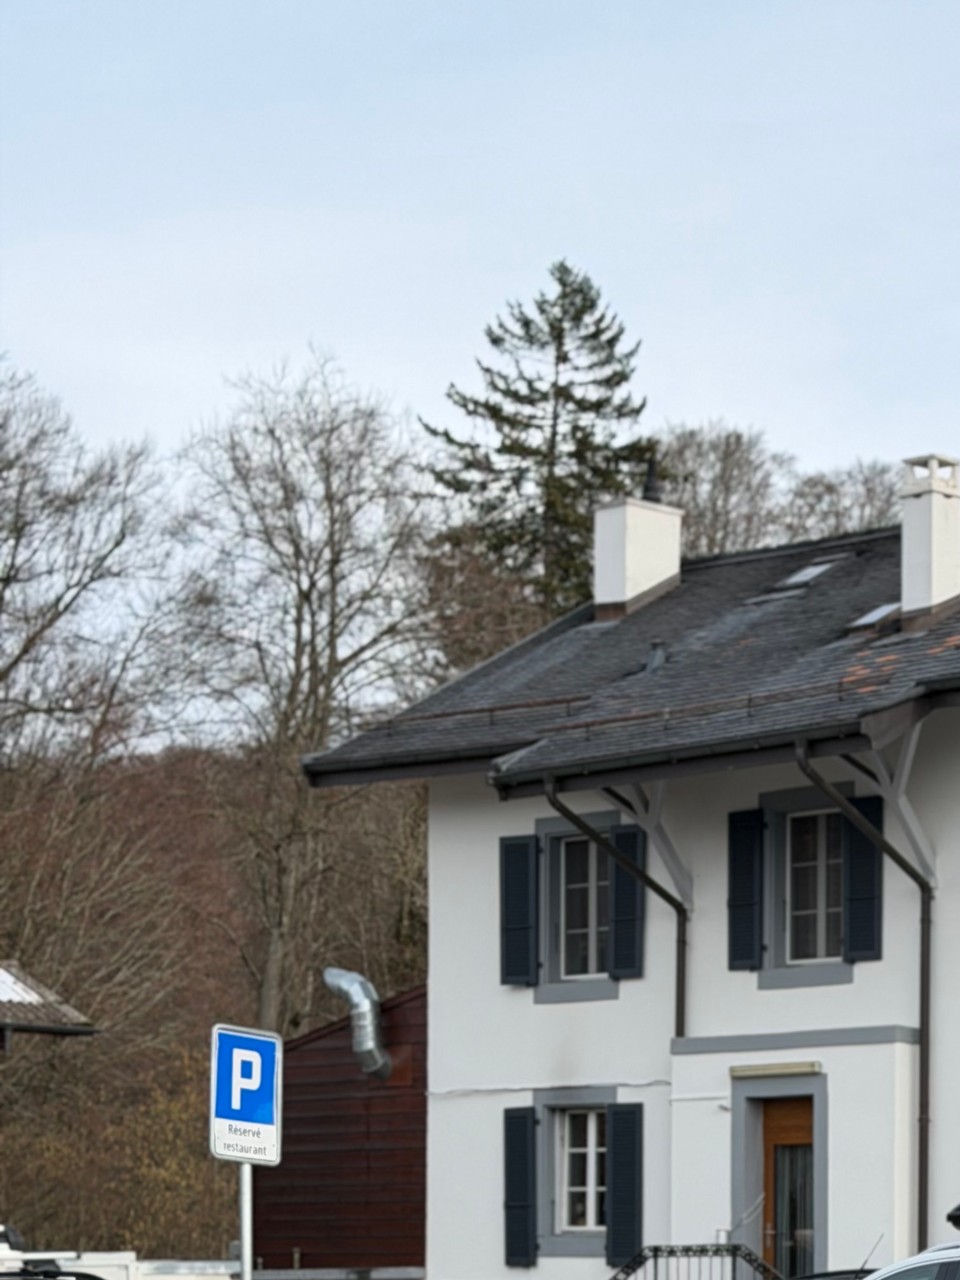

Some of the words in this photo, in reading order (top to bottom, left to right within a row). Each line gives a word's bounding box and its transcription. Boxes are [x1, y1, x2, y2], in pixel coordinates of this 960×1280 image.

[231, 1047, 262, 1110] P
[228, 1123, 262, 1139] Réservé
[223, 1141, 268, 1156] restaurant
